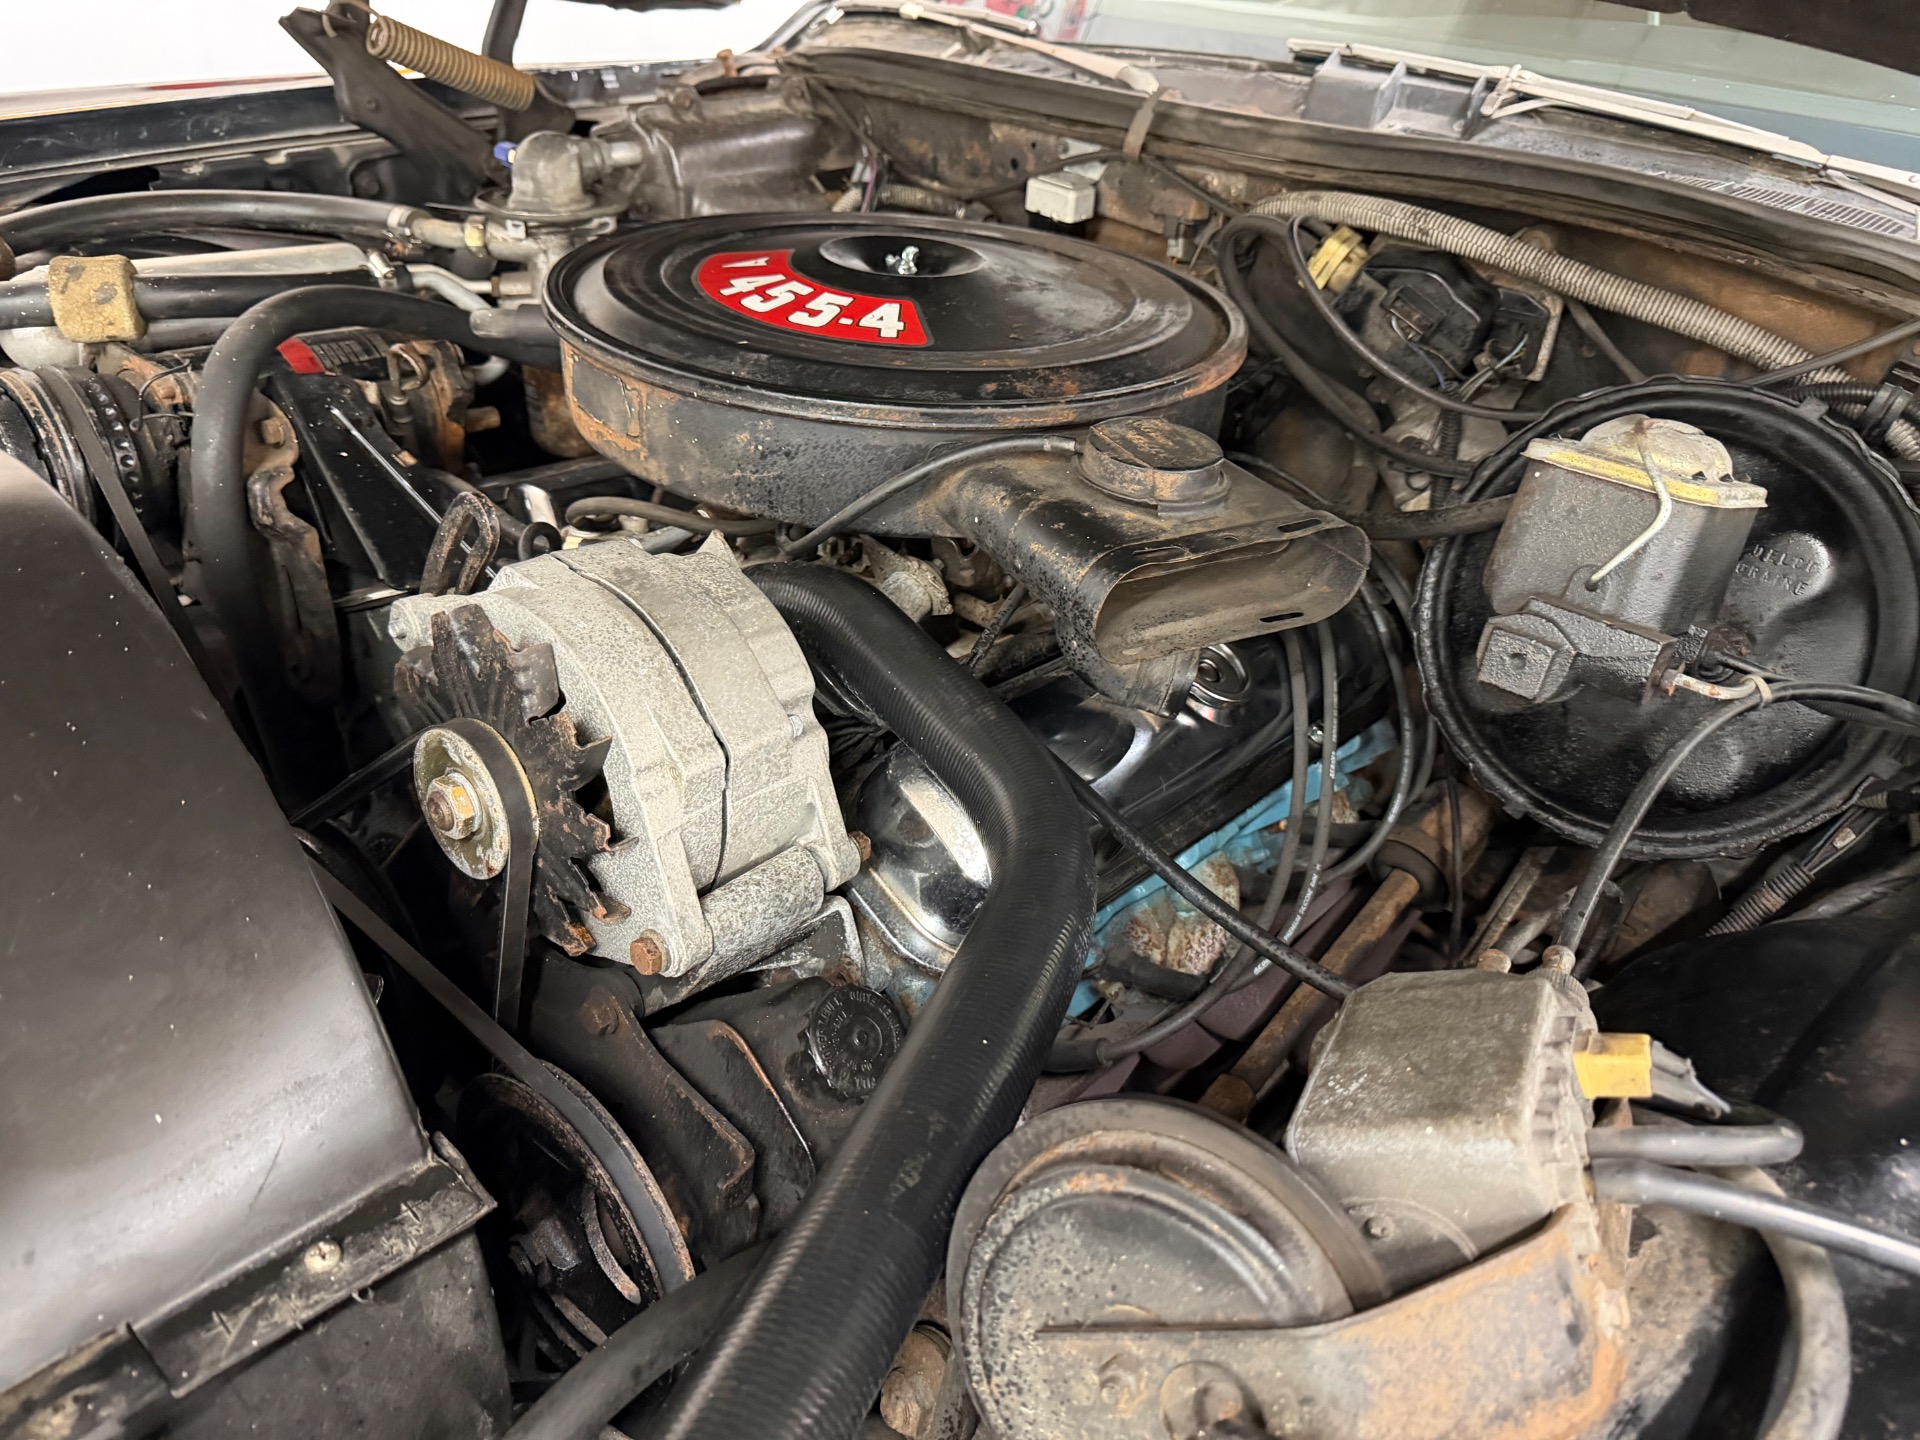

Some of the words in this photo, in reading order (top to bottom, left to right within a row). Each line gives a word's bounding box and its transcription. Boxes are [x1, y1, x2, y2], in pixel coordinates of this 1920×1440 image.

[719, 273, 905, 338] 455-4
[1735, 563, 1808, 595] ORAINE
[1283, 914, 1301, 941] PREMIUM
[1299, 888, 1313, 915] SILICONE
